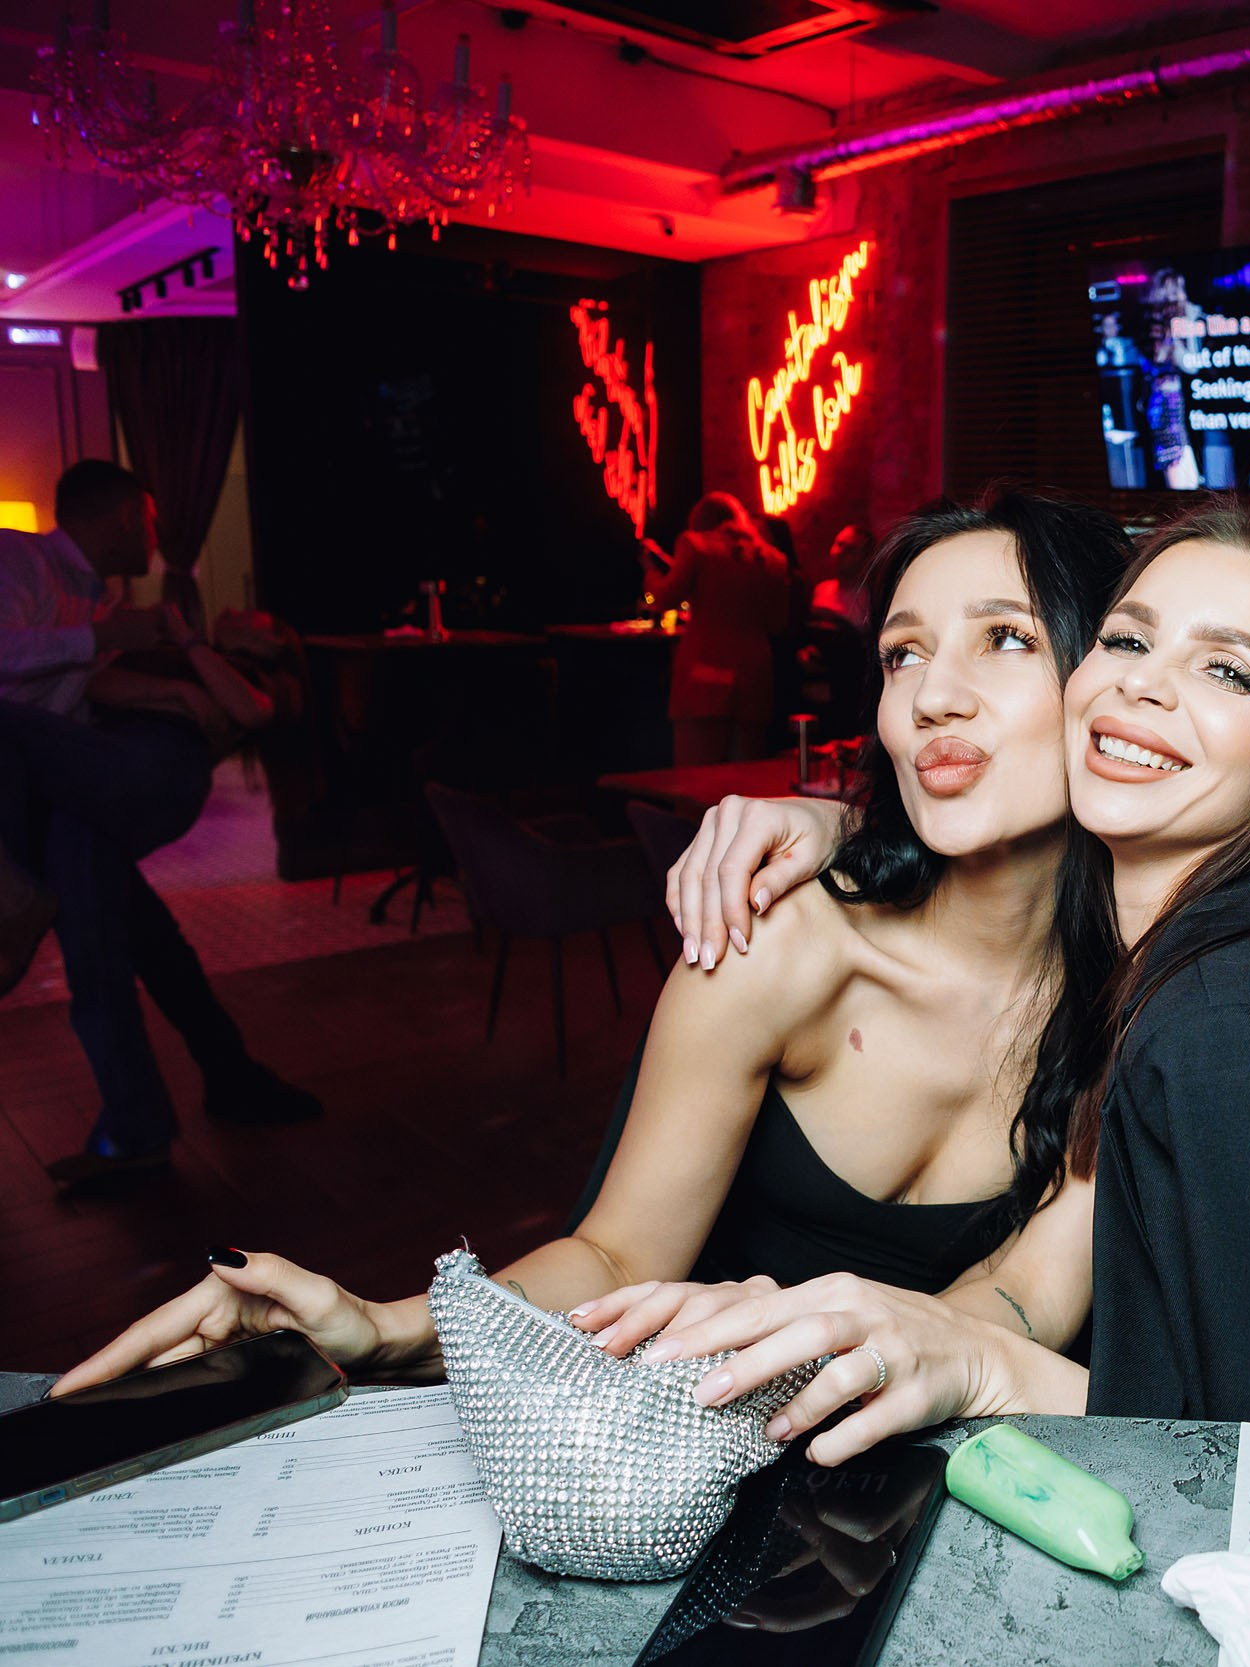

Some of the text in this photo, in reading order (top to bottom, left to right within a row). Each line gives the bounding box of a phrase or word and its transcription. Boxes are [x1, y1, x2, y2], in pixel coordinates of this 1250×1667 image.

[1212, 346, 1232, 368] of
[1189, 409, 1228, 431] than
[378, 1465, 423, 1477] ВОДКА
[352, 1521, 412, 1537] КОНЬЯК
[43, 1553, 103, 1565] ТЕКИЛА
